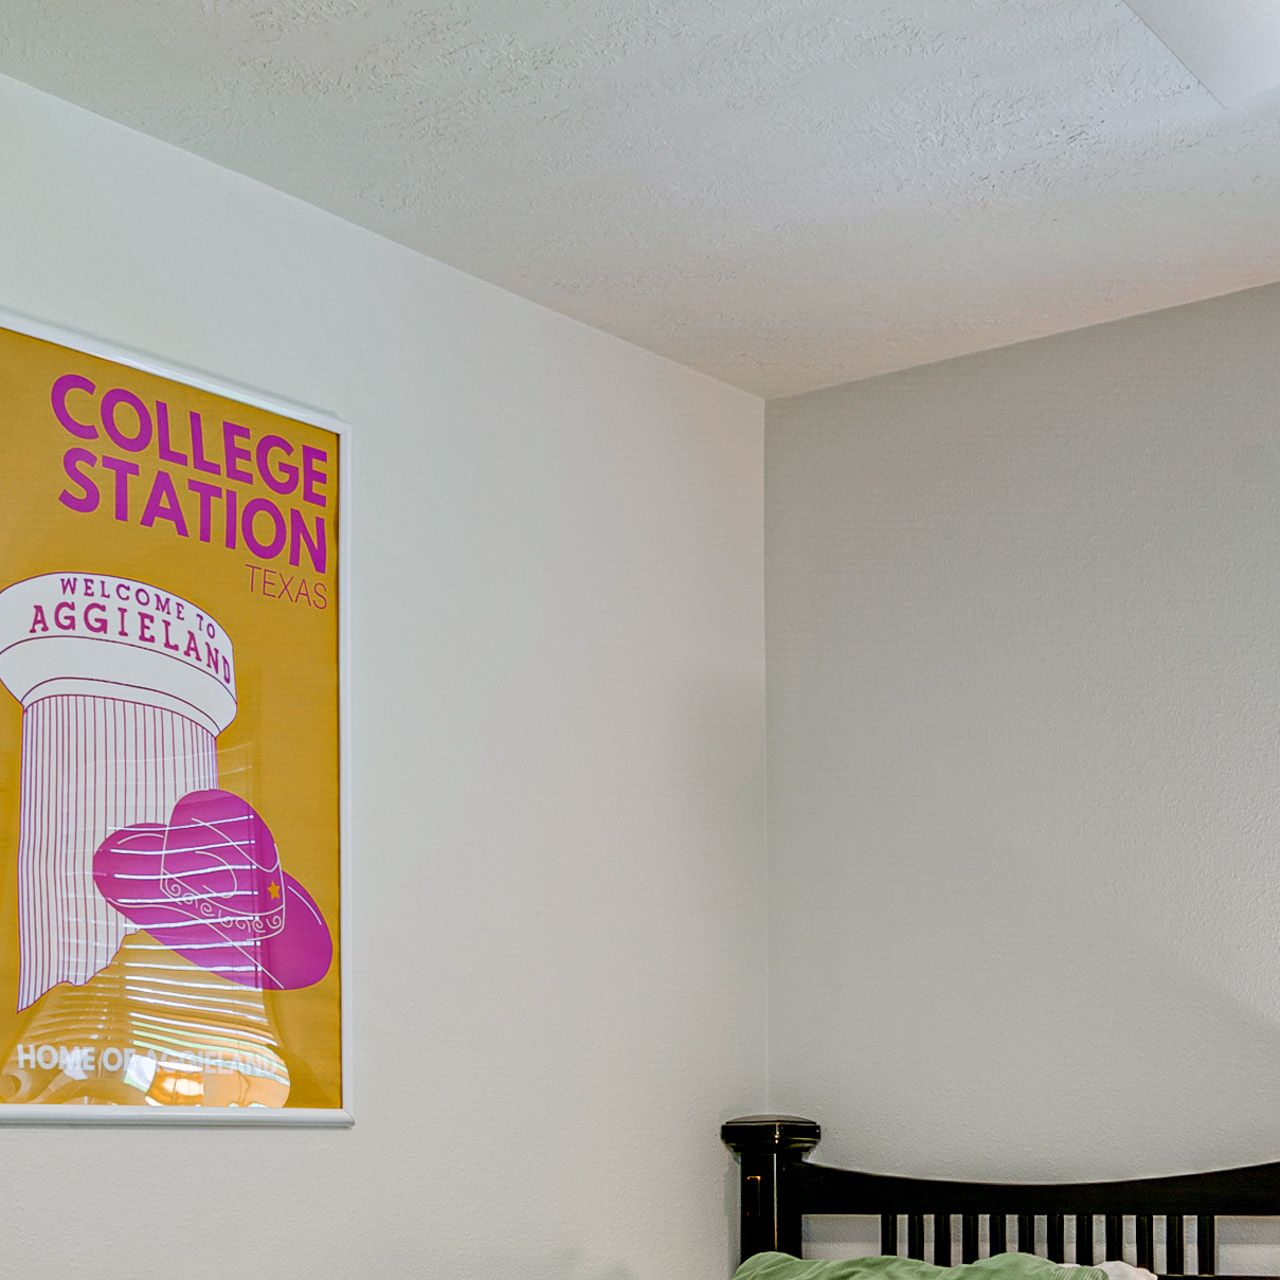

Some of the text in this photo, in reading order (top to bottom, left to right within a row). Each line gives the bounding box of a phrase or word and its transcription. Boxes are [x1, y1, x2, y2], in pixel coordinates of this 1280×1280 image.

[51, 374, 328, 508] COLLEGE
[58, 447, 327, 574] STATION
[60, 577, 216, 639] WELCOME TO
[245, 563, 328, 610] TEXAS
[29, 601, 231, 684] AGGIELAND
[17, 1044, 96, 1071] HOME
